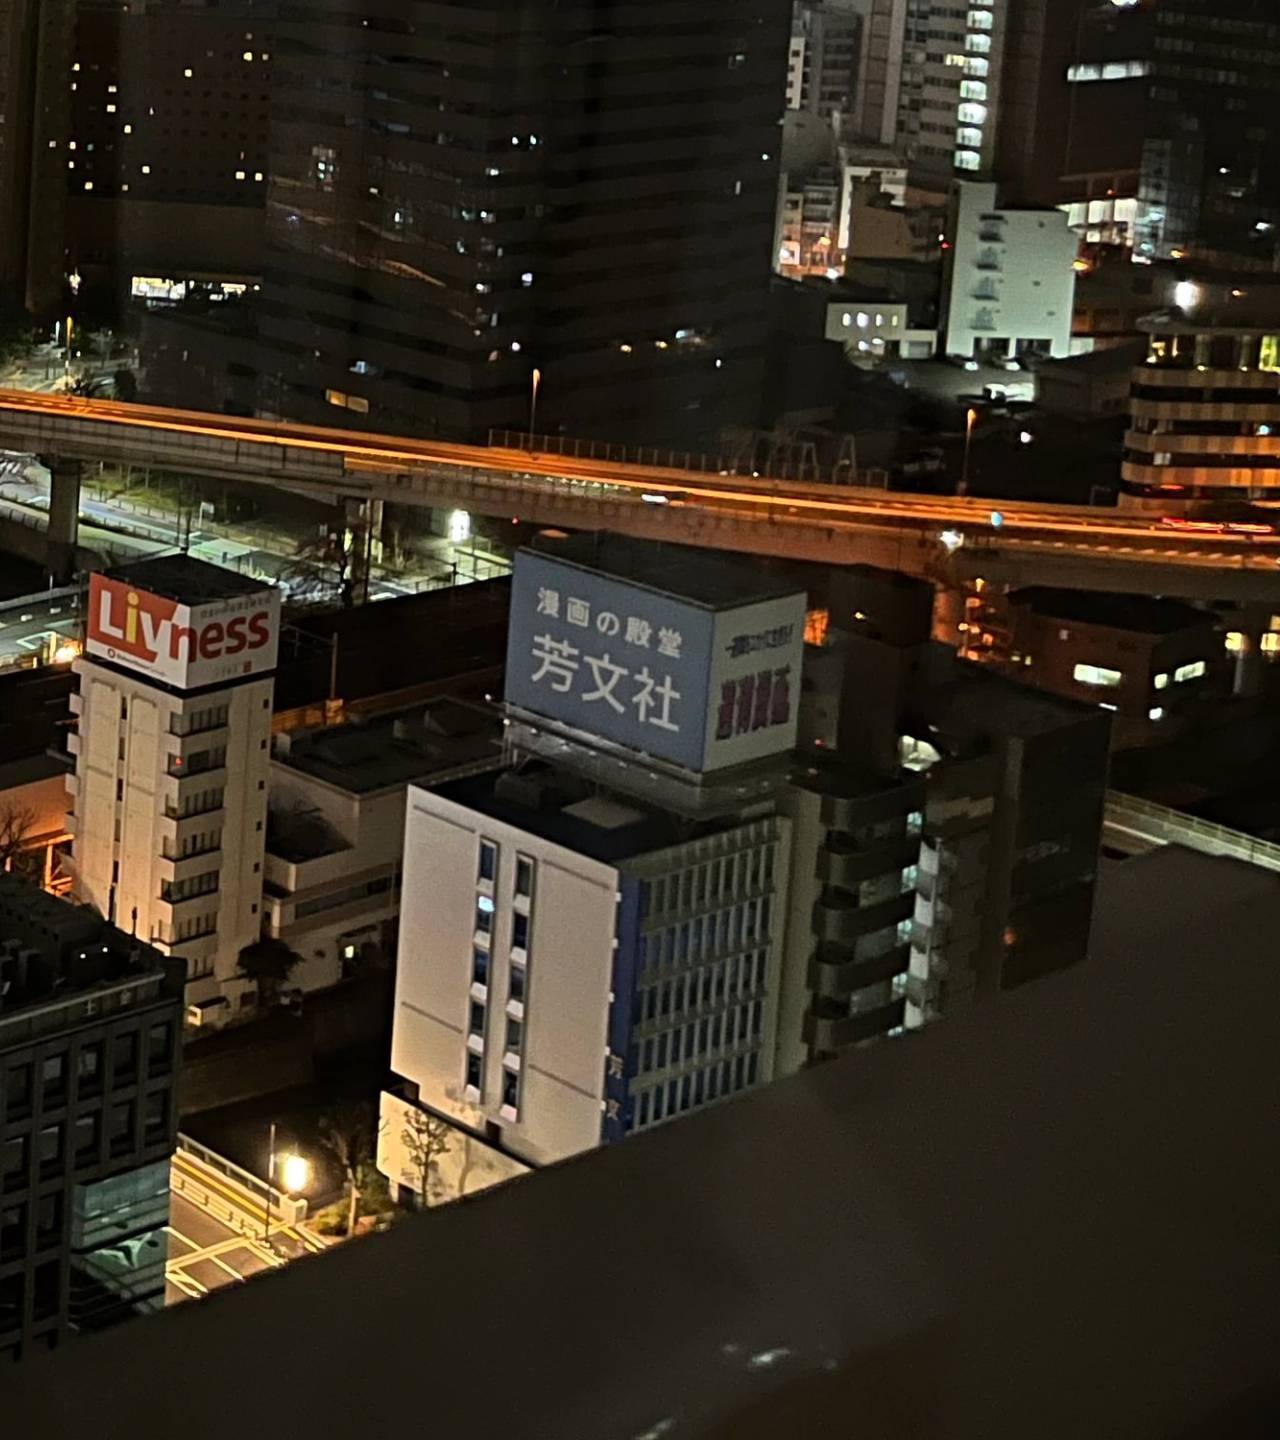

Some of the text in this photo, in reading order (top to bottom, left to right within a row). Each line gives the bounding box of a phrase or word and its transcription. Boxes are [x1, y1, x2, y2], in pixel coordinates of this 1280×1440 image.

[537, 586, 683, 658] 漫画の殿堂
[531, 633, 681, 732] 芳文社
